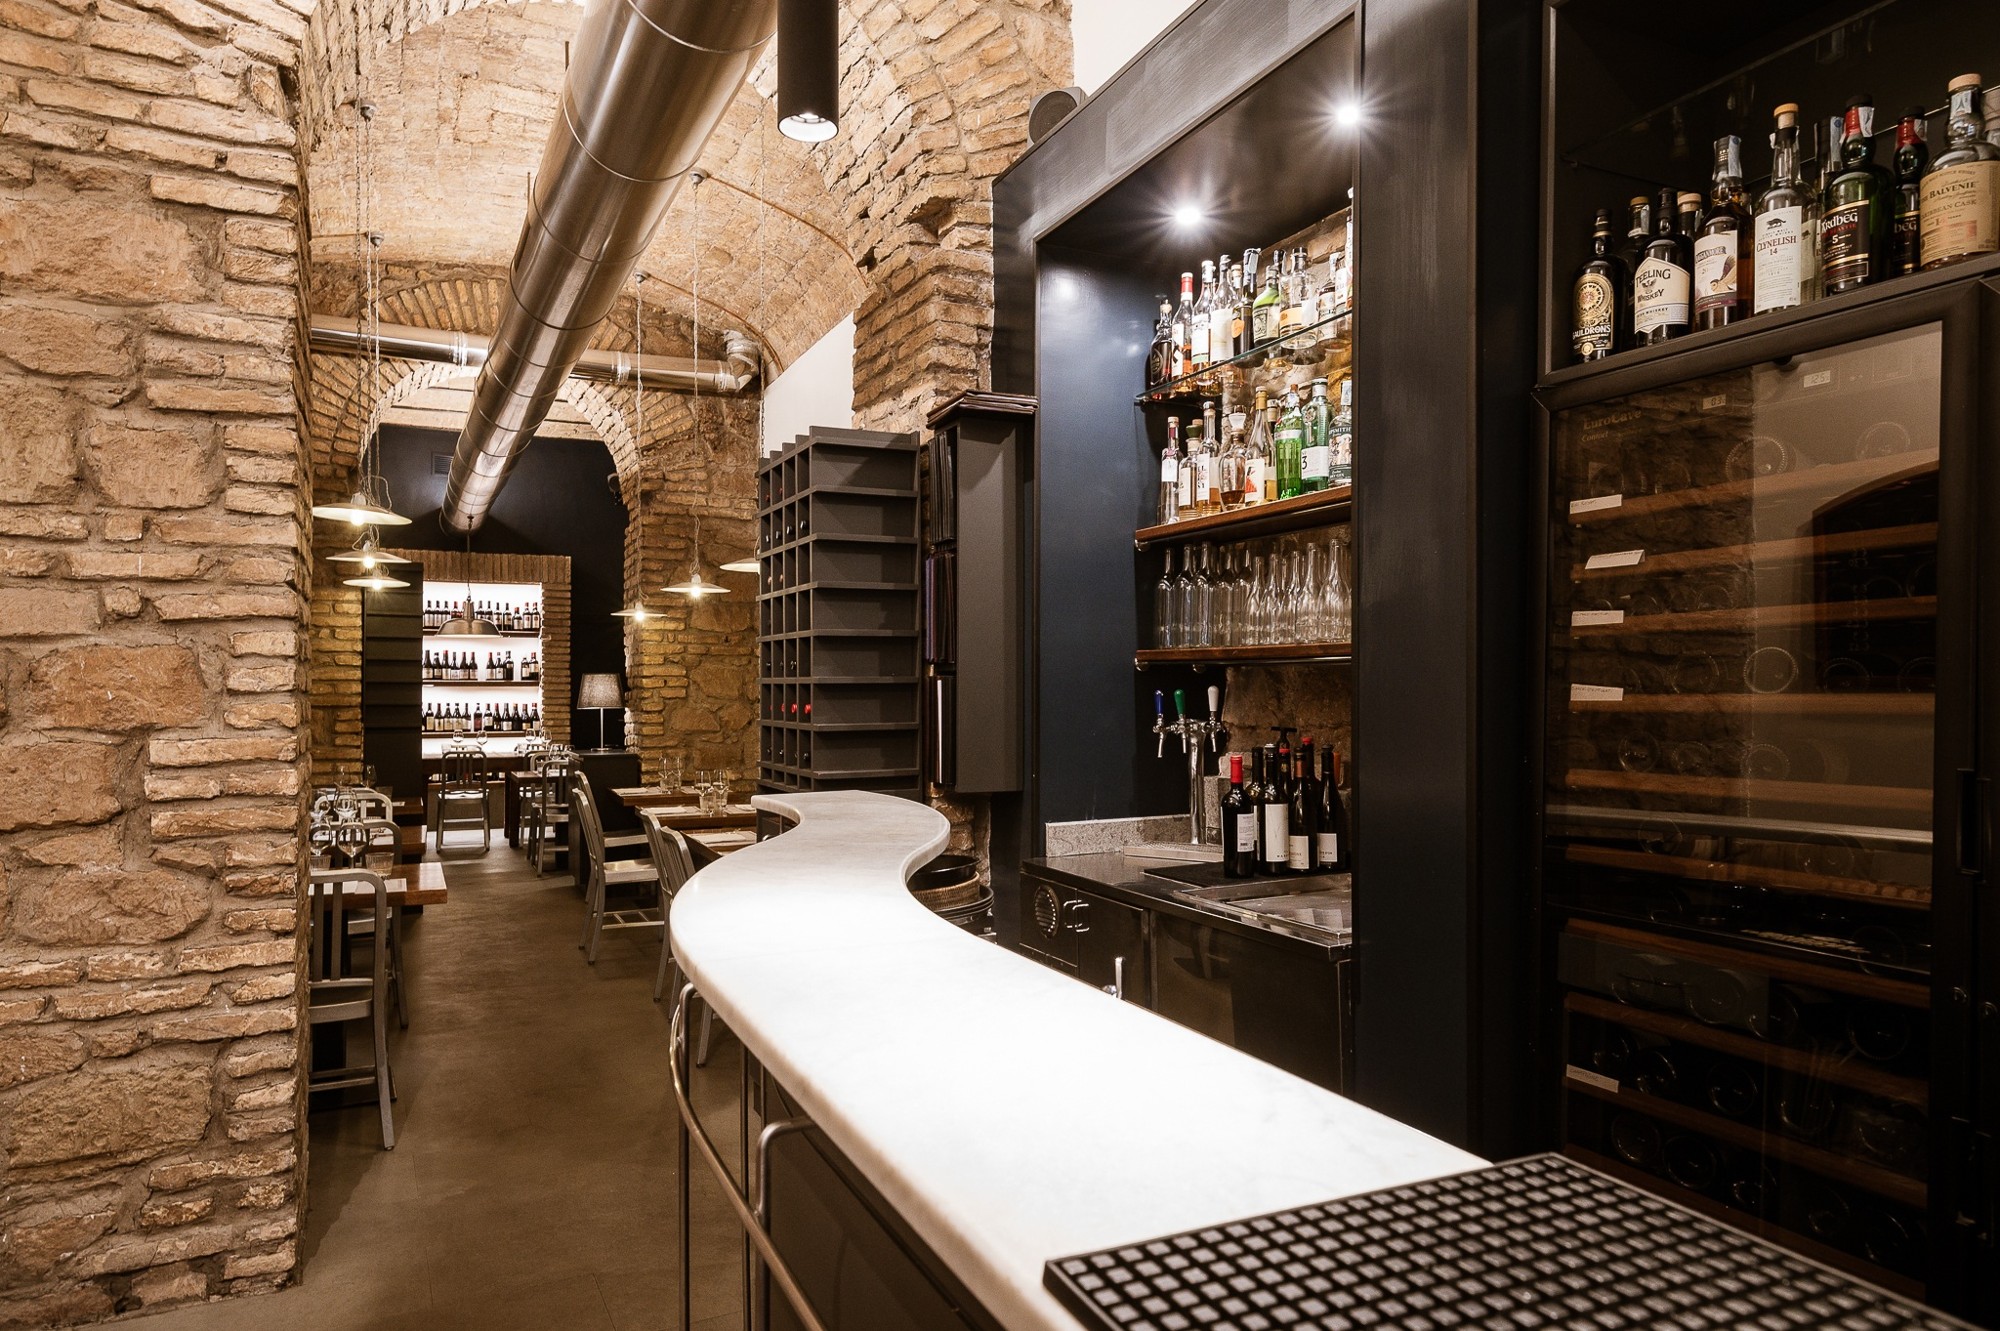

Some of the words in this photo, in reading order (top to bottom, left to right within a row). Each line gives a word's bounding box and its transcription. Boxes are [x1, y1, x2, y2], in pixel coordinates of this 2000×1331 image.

[1929, 182, 1976, 199] BALVENIE
[1954, 199, 1978, 208] CASK
[1757, 235, 1797, 252] CLYNELISH
[1832, 234, 1839, 244] 5
[1769, 248, 1778, 256] 14
[1636, 268, 1671, 288] TEELING
[1637, 289, 1664, 303] WHISKEY
[1583, 409, 1642, 430] EuroCave
